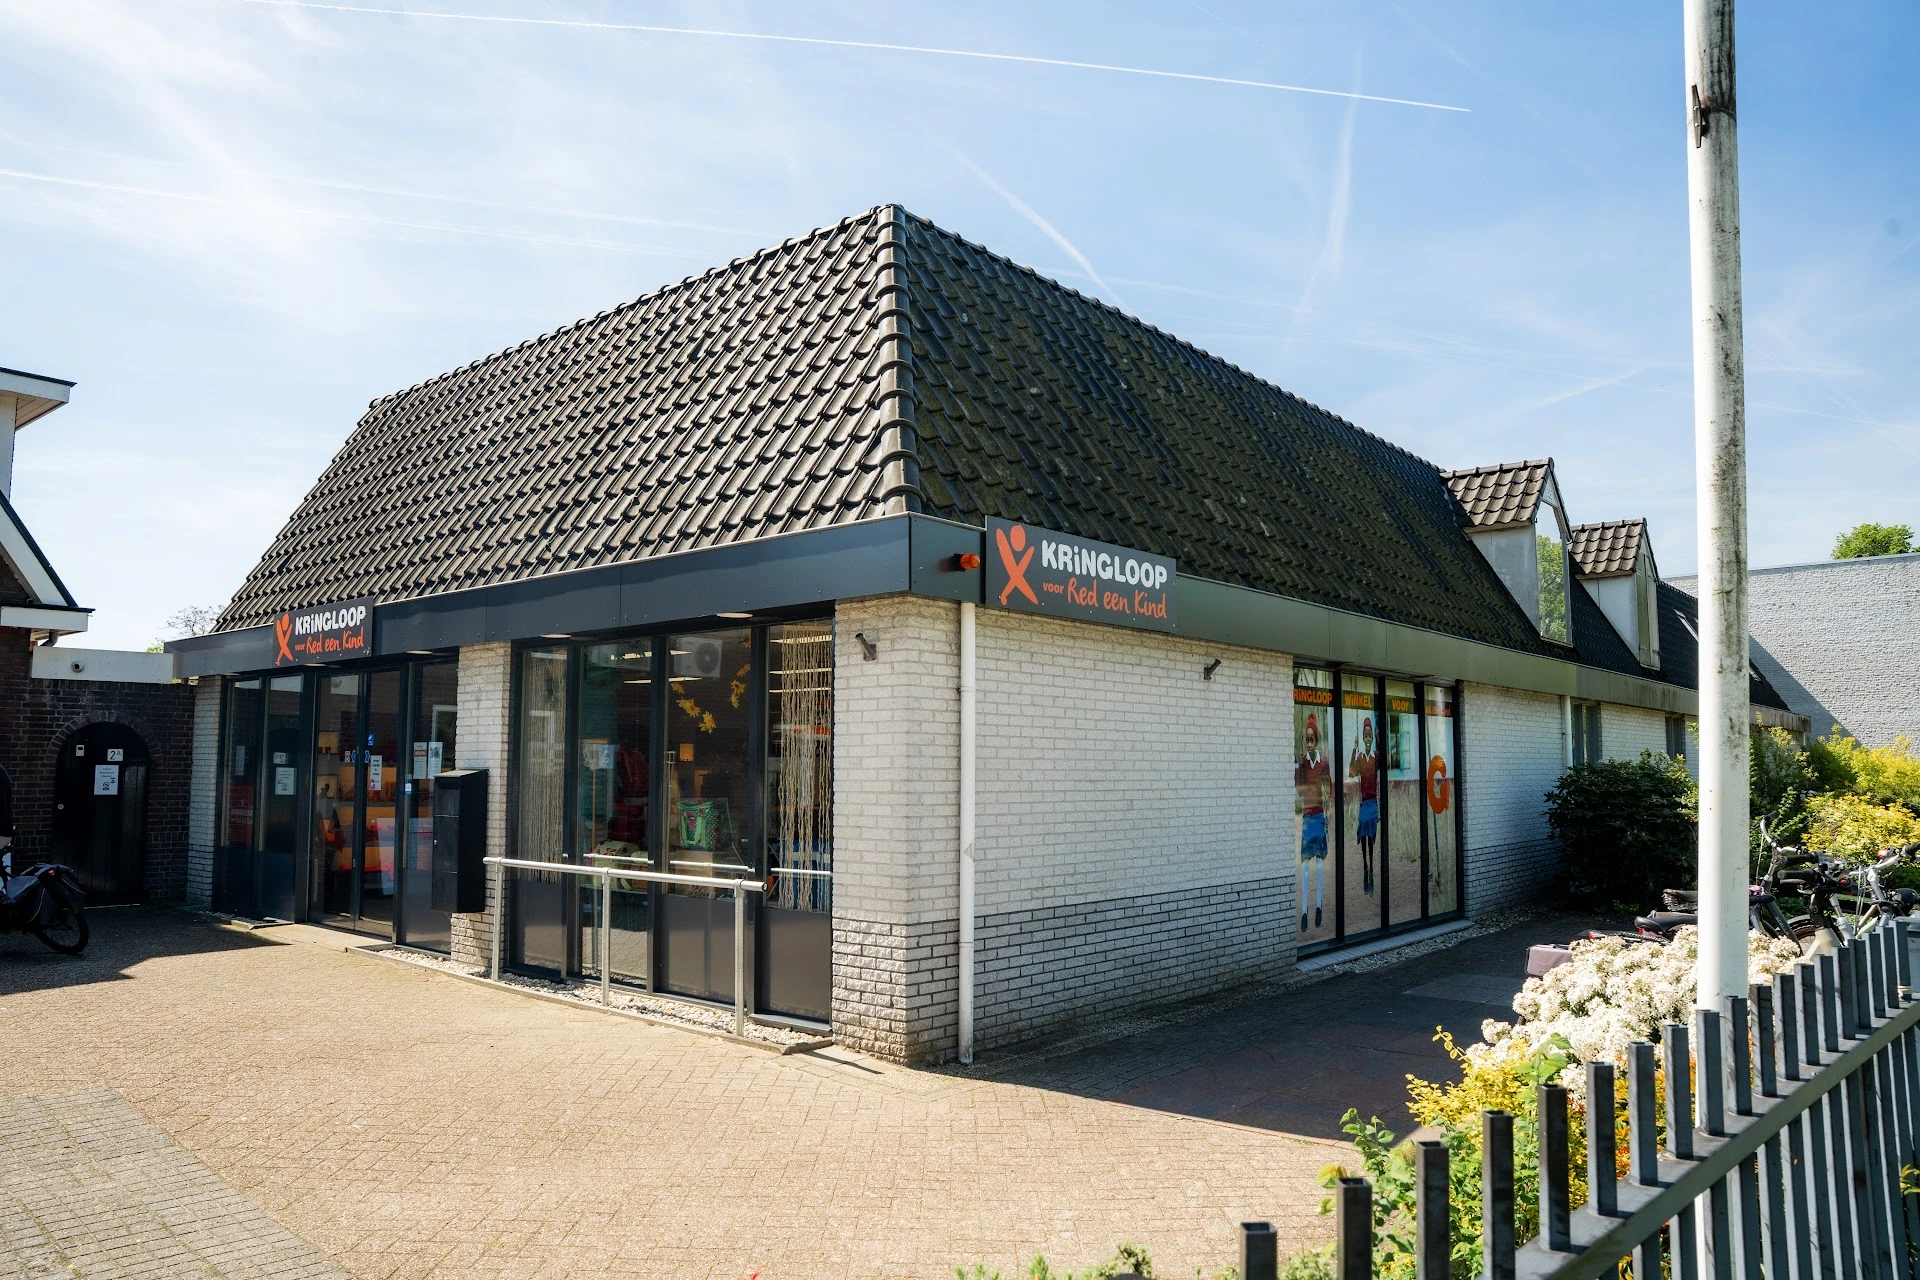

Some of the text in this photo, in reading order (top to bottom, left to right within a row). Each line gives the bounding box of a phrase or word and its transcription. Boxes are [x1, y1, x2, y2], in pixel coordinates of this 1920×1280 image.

[1042, 577, 1168, 619] voor Red een Kind
[306, 633, 323, 654] Red
[324, 637, 341, 652] een
[342, 626, 364, 650] Kind
[1293, 688, 1333, 705] RiNGLOOP
